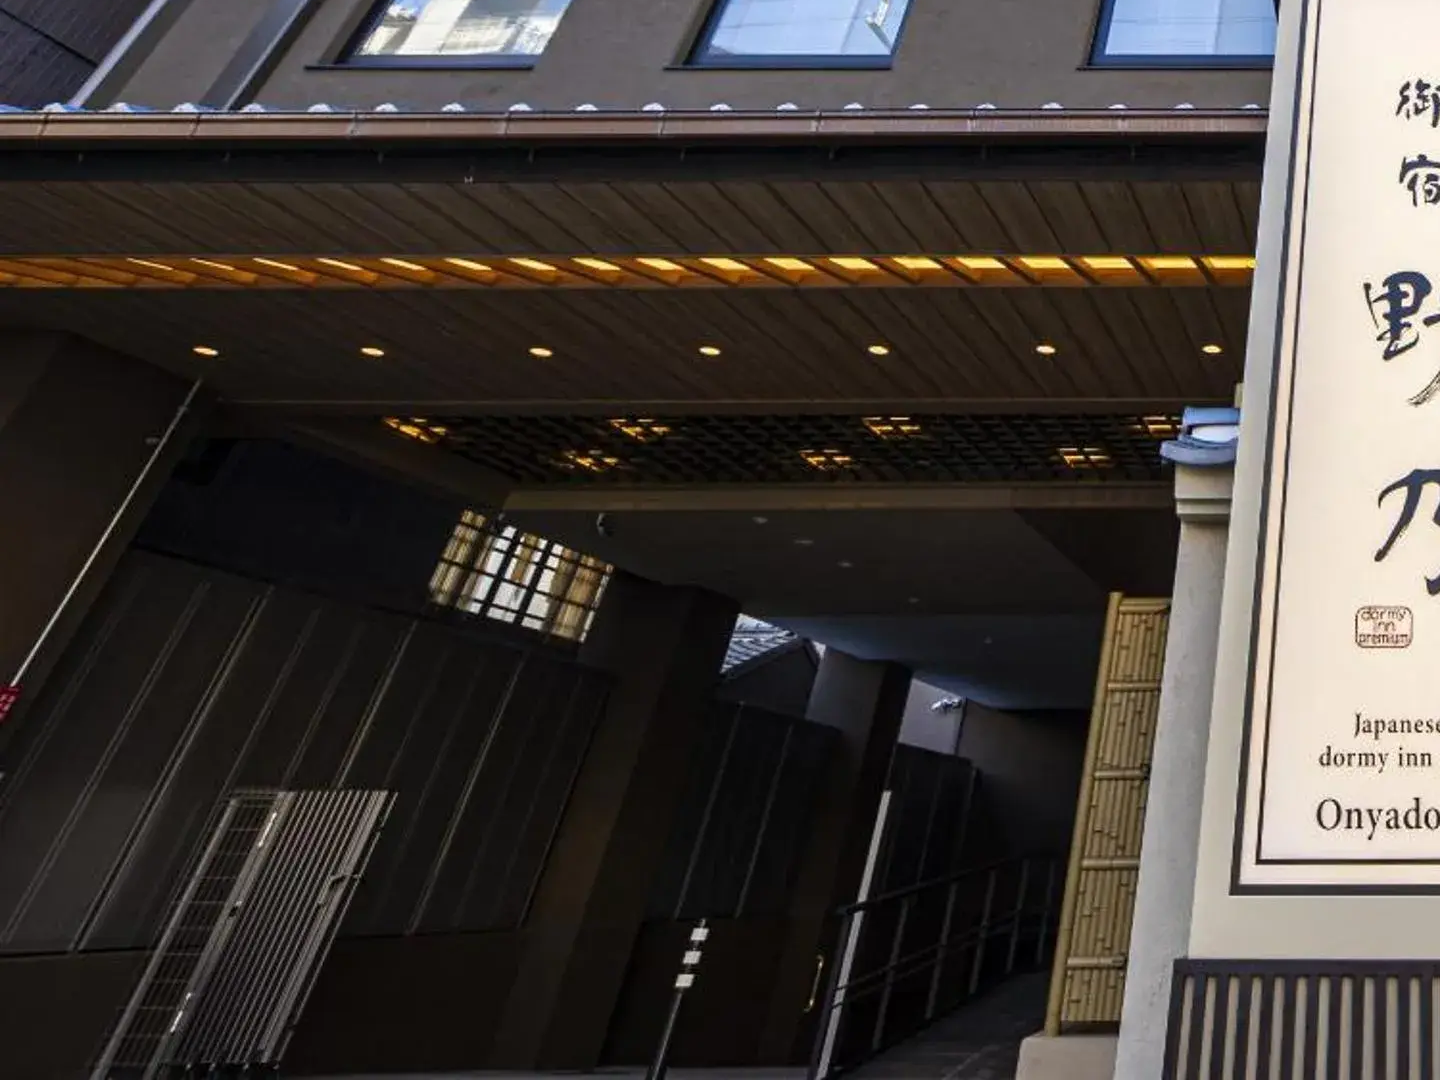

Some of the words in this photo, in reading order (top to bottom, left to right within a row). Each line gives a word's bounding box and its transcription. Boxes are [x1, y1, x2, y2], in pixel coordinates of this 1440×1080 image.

[1361, 607, 1407, 621] dormy
[1373, 620, 1396, 632] inn
[1359, 633, 1409, 645] premium
[1318, 745, 1389, 773] dormy
[1398, 746, 1432, 767] inn
